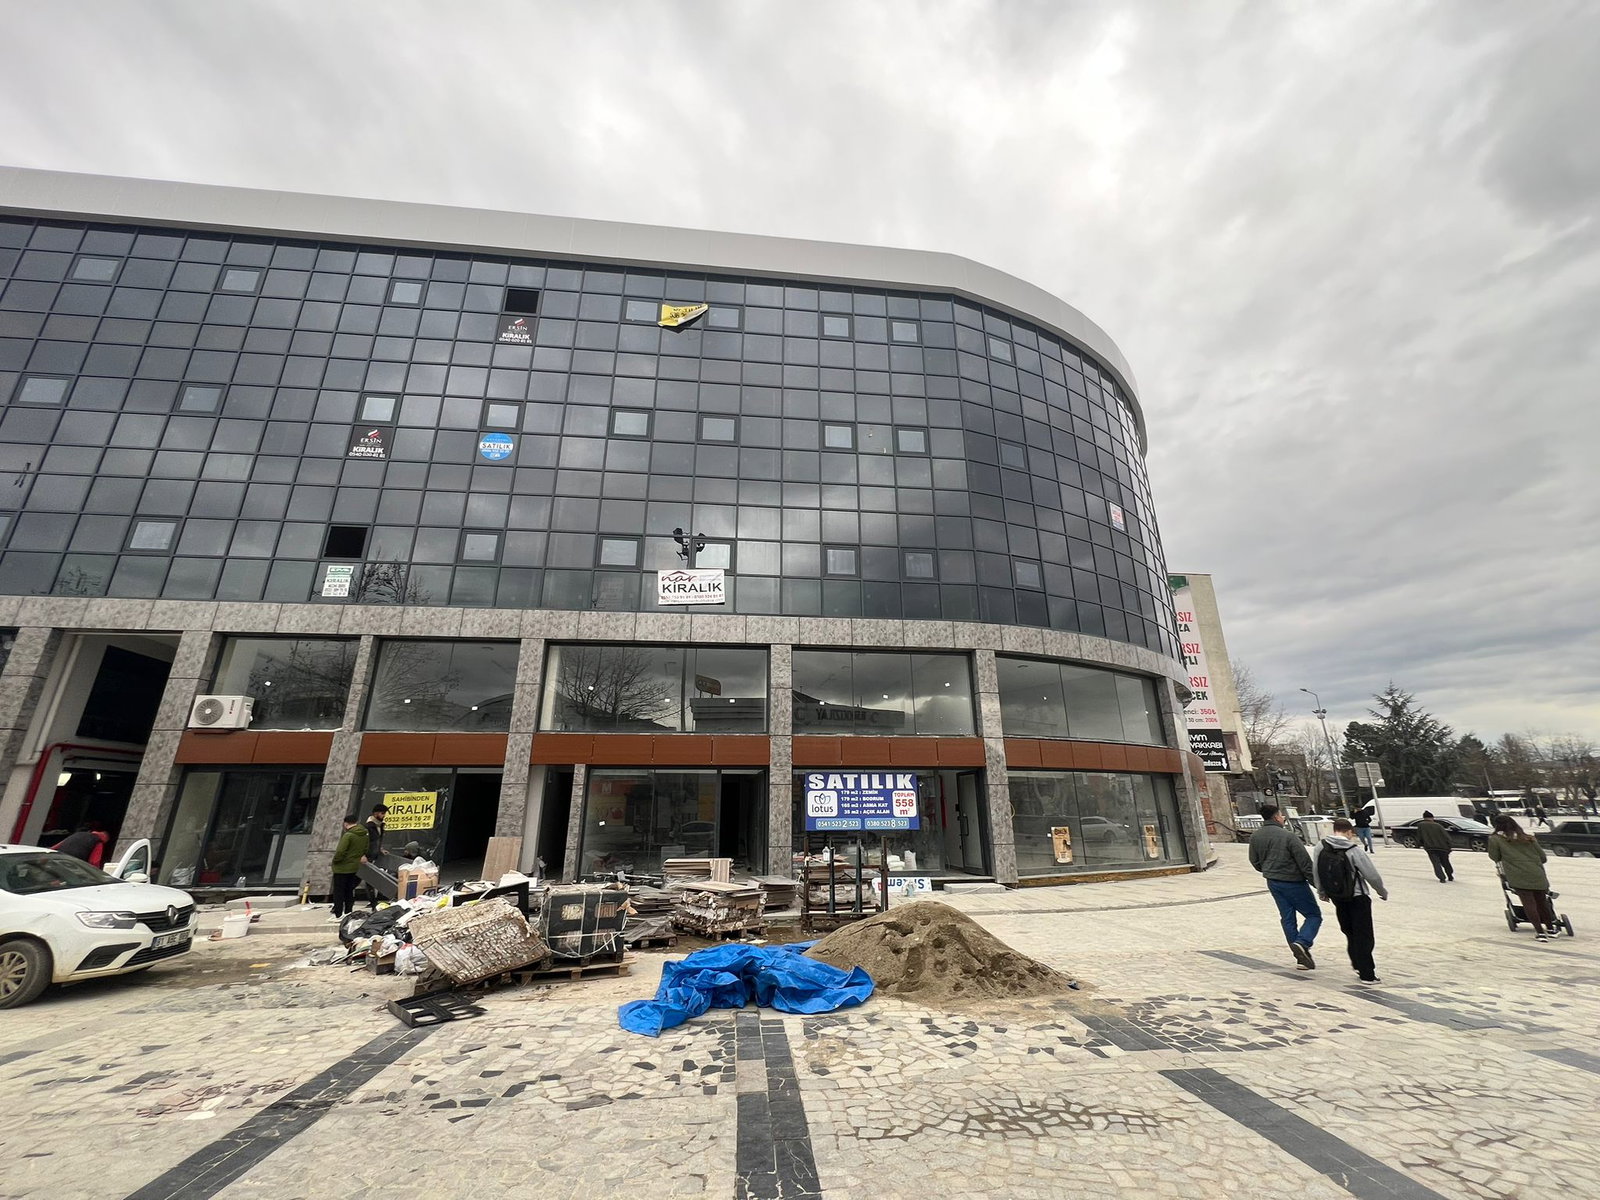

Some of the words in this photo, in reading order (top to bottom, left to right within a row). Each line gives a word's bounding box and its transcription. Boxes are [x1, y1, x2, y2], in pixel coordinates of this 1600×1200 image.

[662, 582, 722, 593] KİRALIK
[808, 773, 914, 790] SATILIK
[895, 799, 914, 807] 558
[812, 805, 833, 813] lotus
